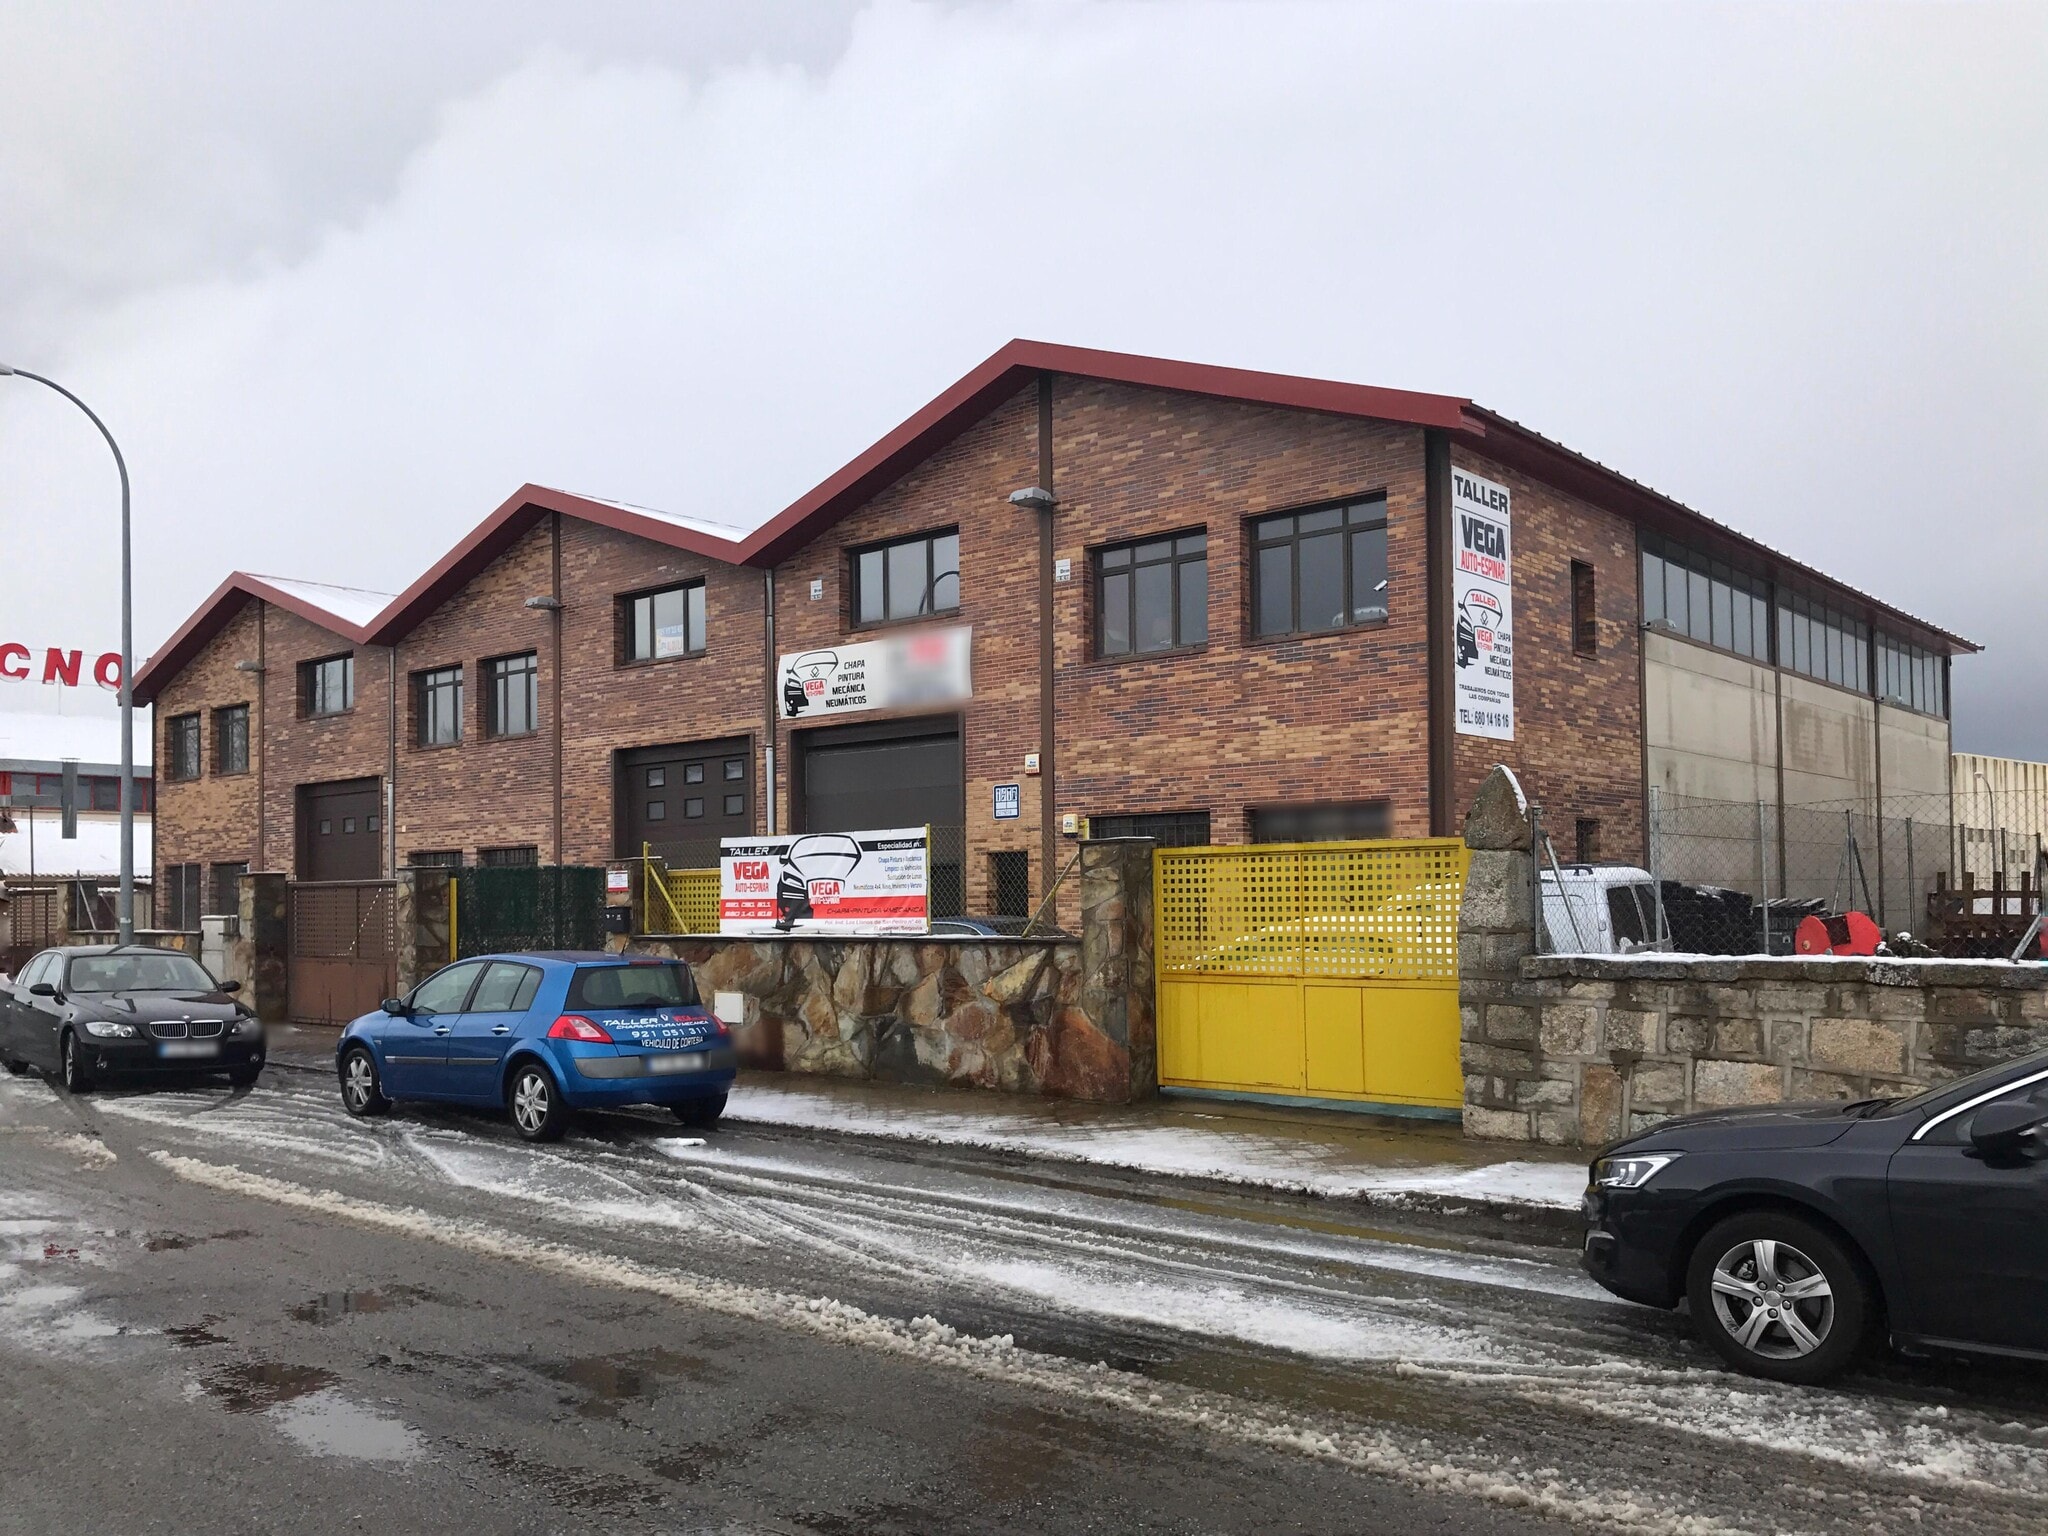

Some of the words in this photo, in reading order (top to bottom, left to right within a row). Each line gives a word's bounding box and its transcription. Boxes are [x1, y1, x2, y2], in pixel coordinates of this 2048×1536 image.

[1454, 475, 1508, 514] TALLER
[1461, 514, 1506, 560] VEGA
[1461, 550, 1506, 581] AUTO-ESPINAR
[1471, 593, 1496, 609] TALLER
[1477, 629, 1493, 643] VEGA
[1497, 631, 1511, 642] CHAPA
[1494, 643, 1511, 655] PINTURA
[844, 659, 865, 670] CHAPA
[838, 671, 865, 682] PINTURA
[805, 680, 825, 691] VEGA
[832, 682, 866, 695] MECÁNICA
[1459, 684, 1486, 694] TRABAJAMOS
[826, 694, 867, 708] NEUMÁTICOS
[1459, 709, 1474, 724] TEL:
[1475, 711, 1485, 726] 680
[1486, 712, 1493, 726] 14
[1495, 713, 1501, 727] 16
[1502, 714, 1509, 728] 16
[877, 841, 912, 850] Especialidad
[730, 847, 770, 857] TALLER
[733, 862, 770, 880] VEGA
[735, 883, 769, 892] AUTO-ESPINAR
[811, 881, 841, 896] VEGA
[603, 1018, 658, 1026] TALLER
[616, 1022, 676, 1030] CHAPA-PINTURA
[632, 1030, 657, 1038] 921
[662, 1029, 685, 1037] 051
[689, 1027, 708, 1035] 311
[641, 1038, 671, 1049] VEHICULO
[672, 1038, 680, 1050] DE
[680, 1036, 704, 1048] CORTESIA
